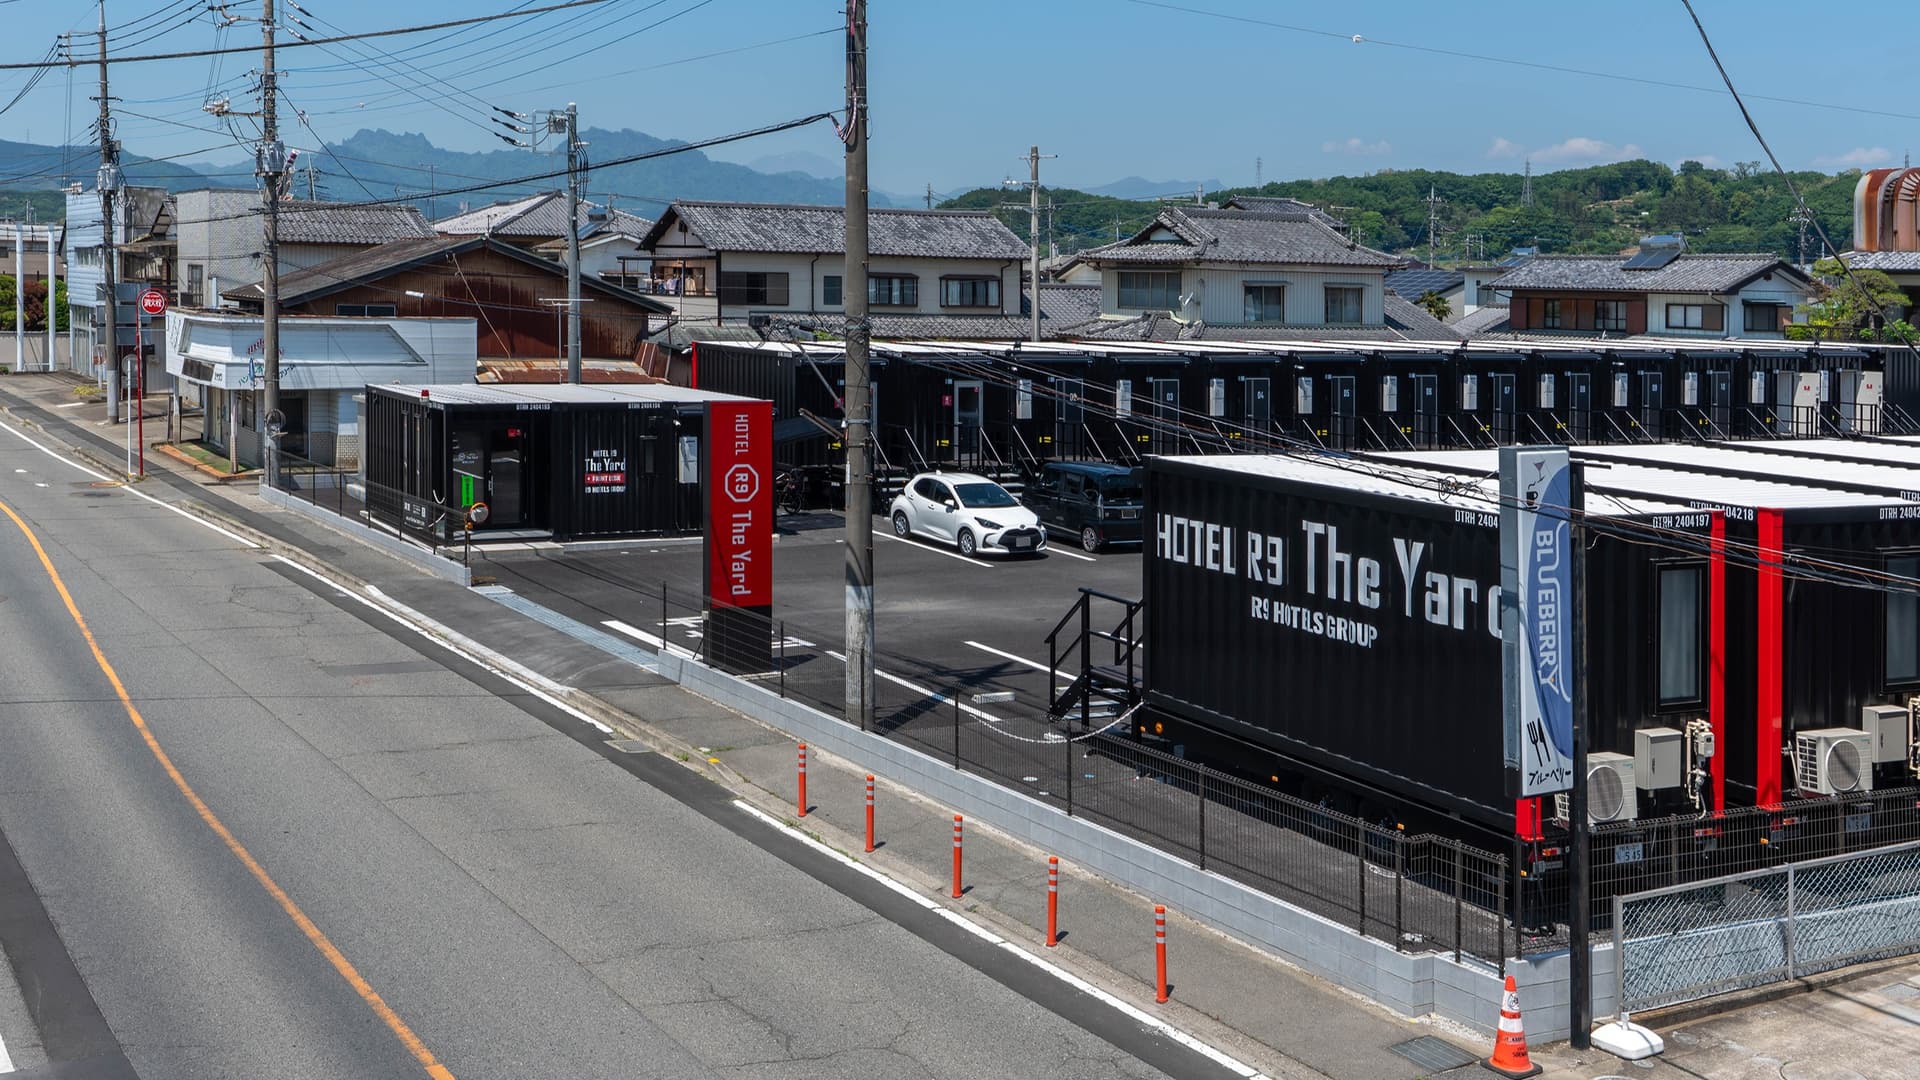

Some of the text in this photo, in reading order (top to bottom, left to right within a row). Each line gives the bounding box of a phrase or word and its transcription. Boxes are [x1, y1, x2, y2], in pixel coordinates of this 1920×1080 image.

[584, 458, 626, 472] The Yard
[732, 414, 752, 596] HOTEL R9 The Yard
[1879, 507, 1898, 520] DTRH
[1455, 509, 1476, 525] DTRH
[1675, 514, 1710, 528] 2404197
[1156, 511, 1237, 575] HOTEL
[1247, 530, 1288, 587] R9
[1302, 519, 1381, 610] The
[1535, 527, 1561, 697] BLUEBERRY
[1251, 595, 1378, 649] R9 HOTELS GROUP
[1528, 768, 1572, 786] ブルーベリー
